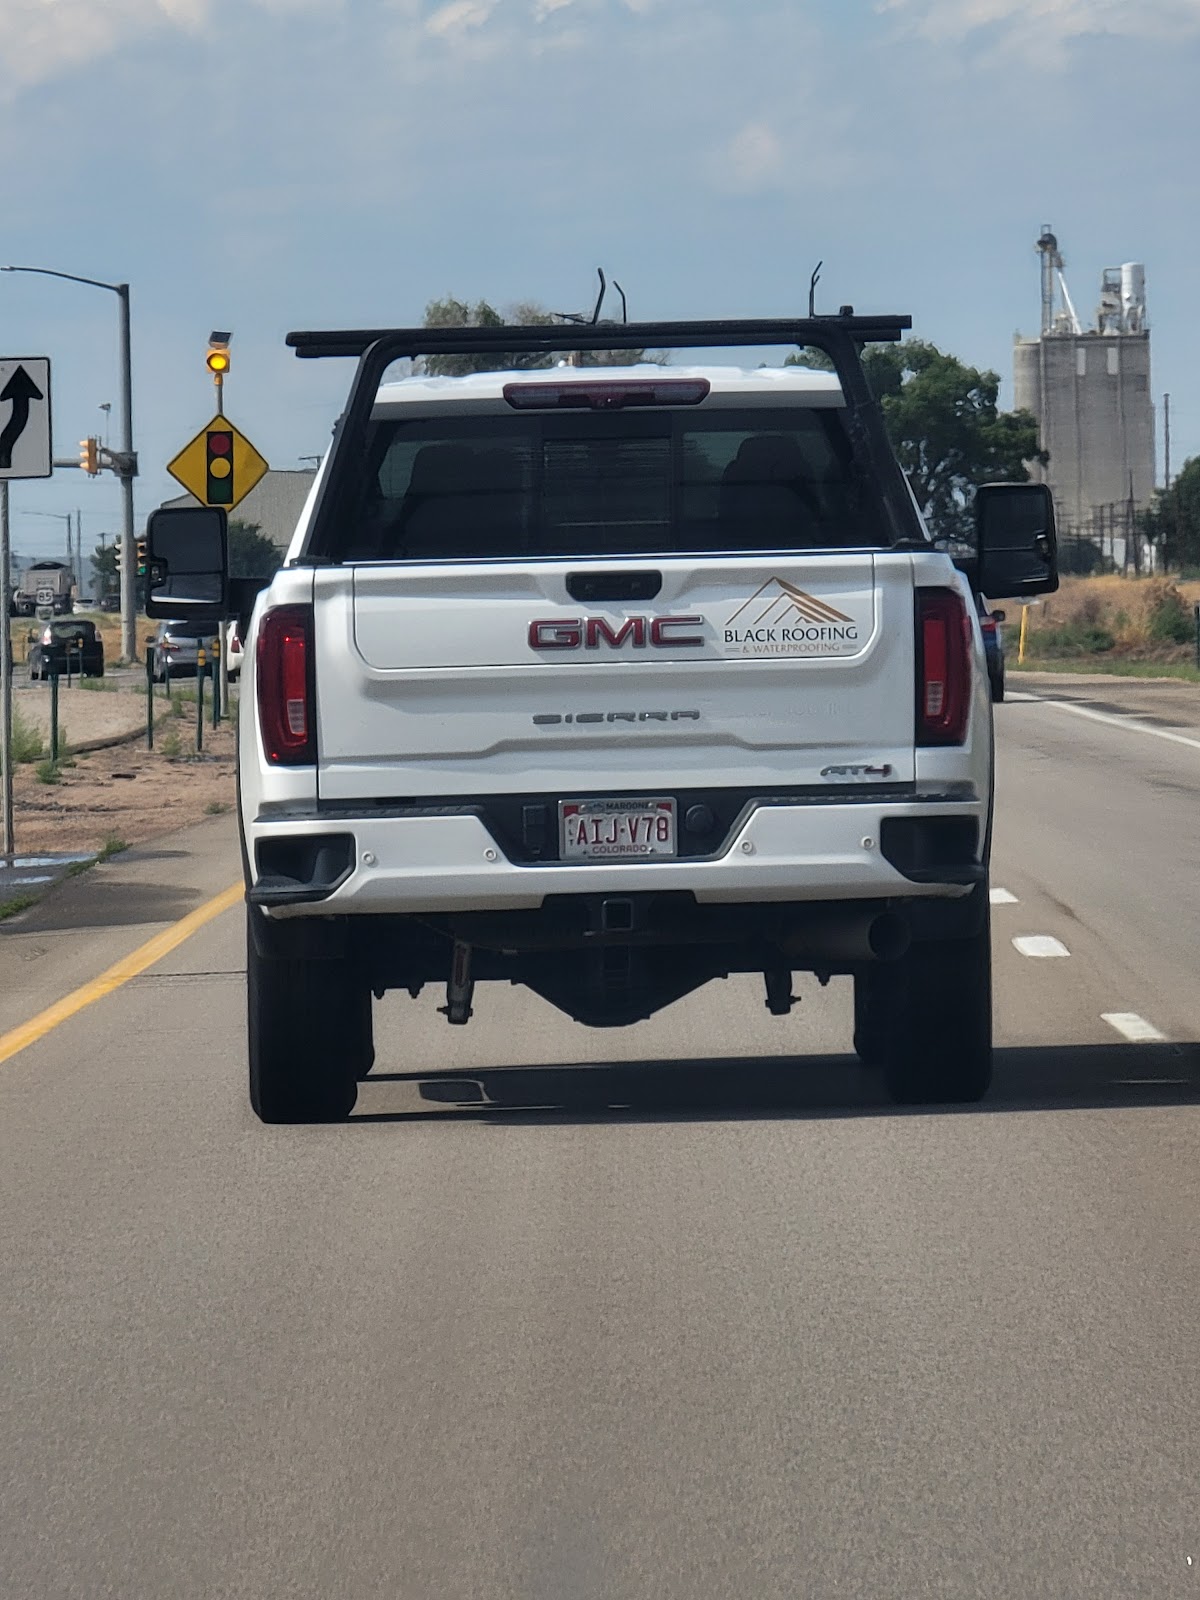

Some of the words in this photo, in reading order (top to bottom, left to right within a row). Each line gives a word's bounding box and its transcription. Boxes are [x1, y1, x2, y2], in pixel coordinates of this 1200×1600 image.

[528, 615, 704, 650] GMC
[724, 629, 776, 643] BLACK
[782, 626, 858, 641] ROOFING
[753, 642, 840, 653] WATERPROOFING
[592, 844, 647, 854] COLORADO
